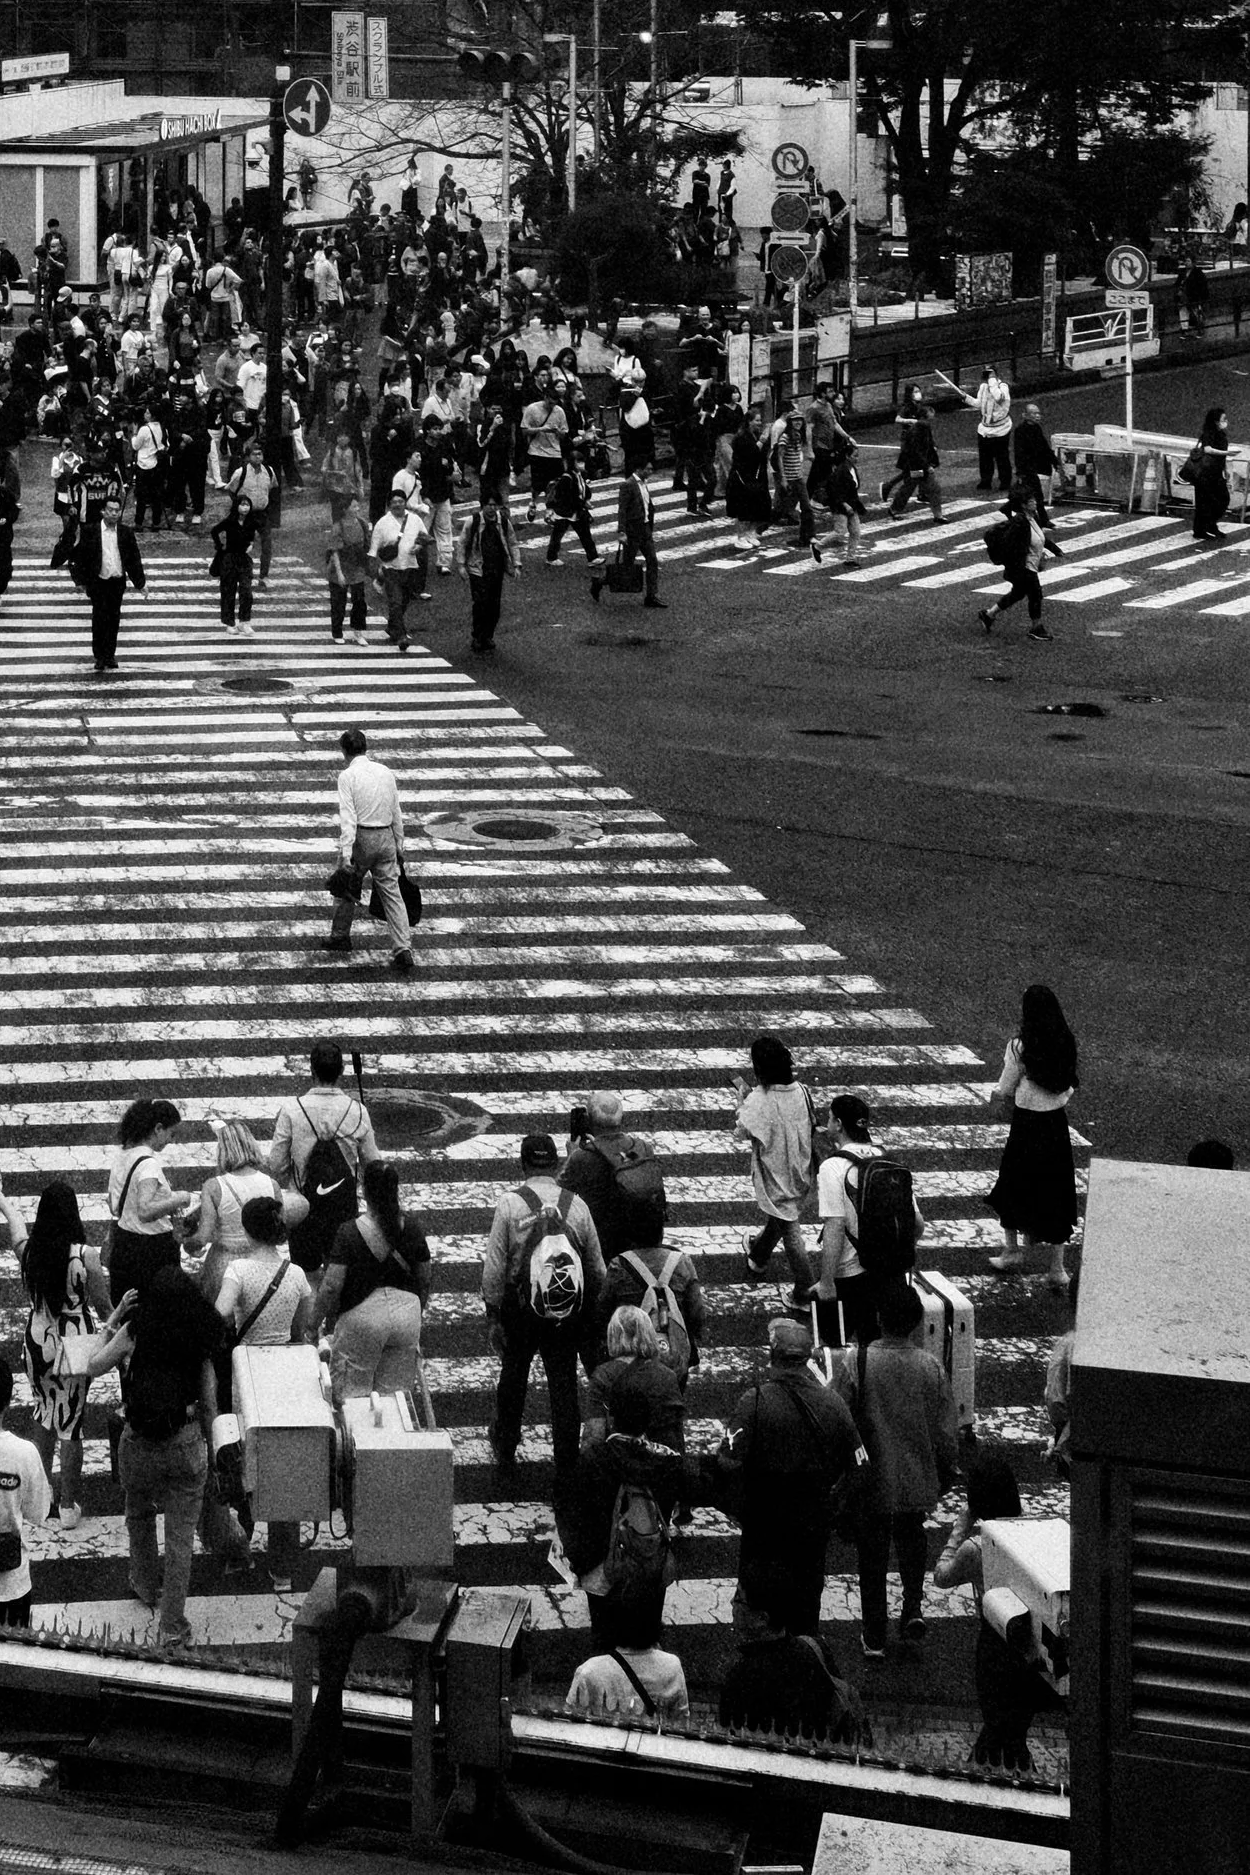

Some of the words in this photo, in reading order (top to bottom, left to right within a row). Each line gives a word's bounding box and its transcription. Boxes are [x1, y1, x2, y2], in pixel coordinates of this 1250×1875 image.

[335, 32, 345, 67] Shibuya
[345, 20, 360, 98] 渋谷駅前
[1108, 295, 1146, 305] ここまで
